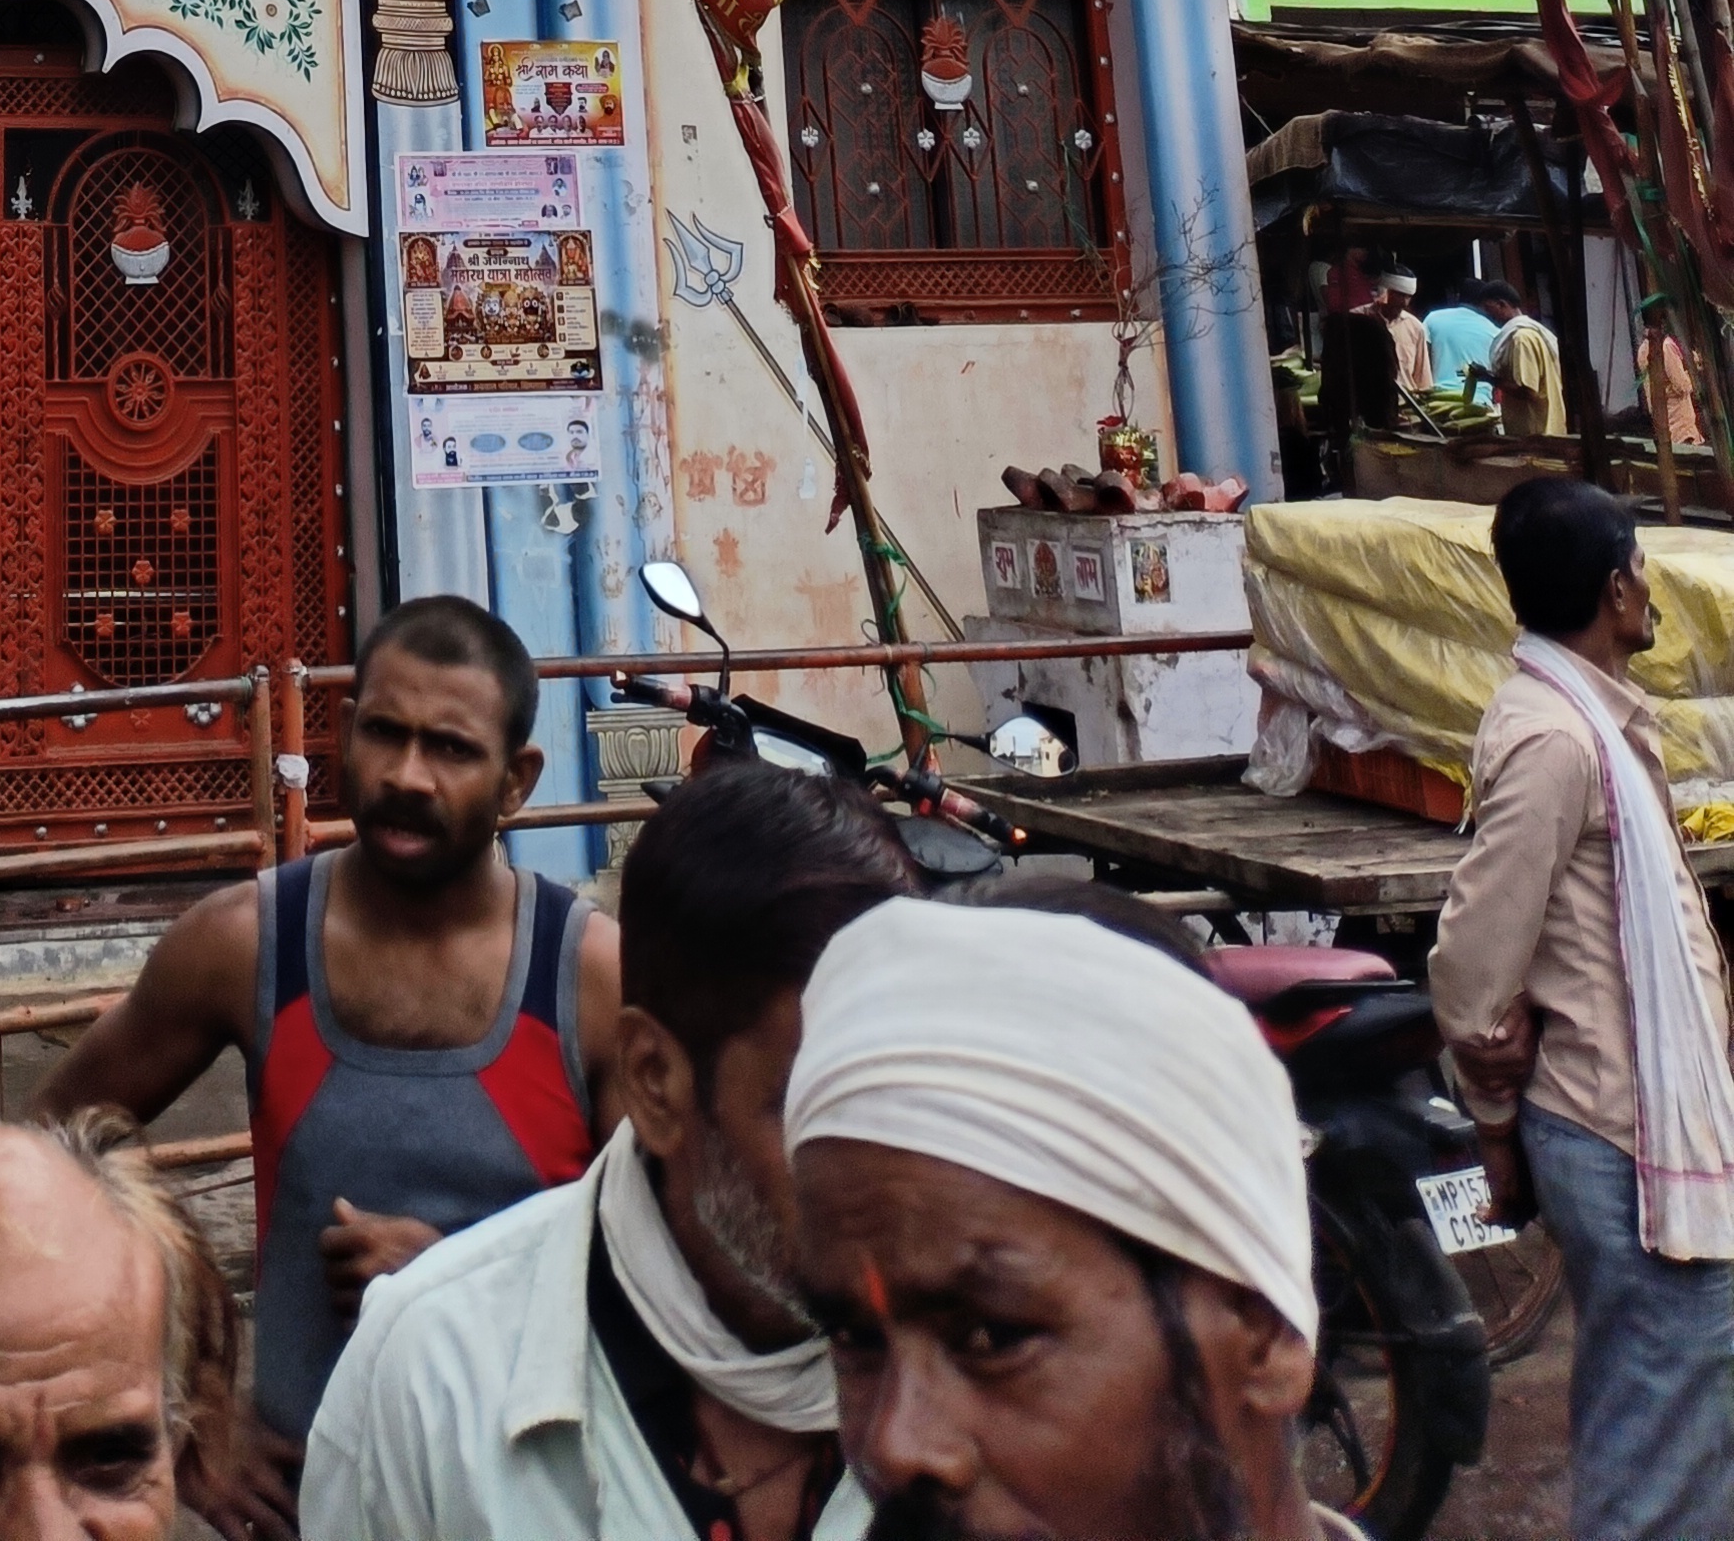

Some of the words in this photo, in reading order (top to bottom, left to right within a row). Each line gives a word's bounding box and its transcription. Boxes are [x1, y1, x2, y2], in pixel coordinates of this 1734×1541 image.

[536, 65, 558, 79] राम
[562, 64, 588, 78] कथा
[467, 253, 480, 266] श्री
[482, 255, 530, 267] जगन्नाथ
[450, 267, 485, 283] महारथ
[487, 268, 511, 282] यात्रा
[514, 265, 552, 283] महोत्सव
